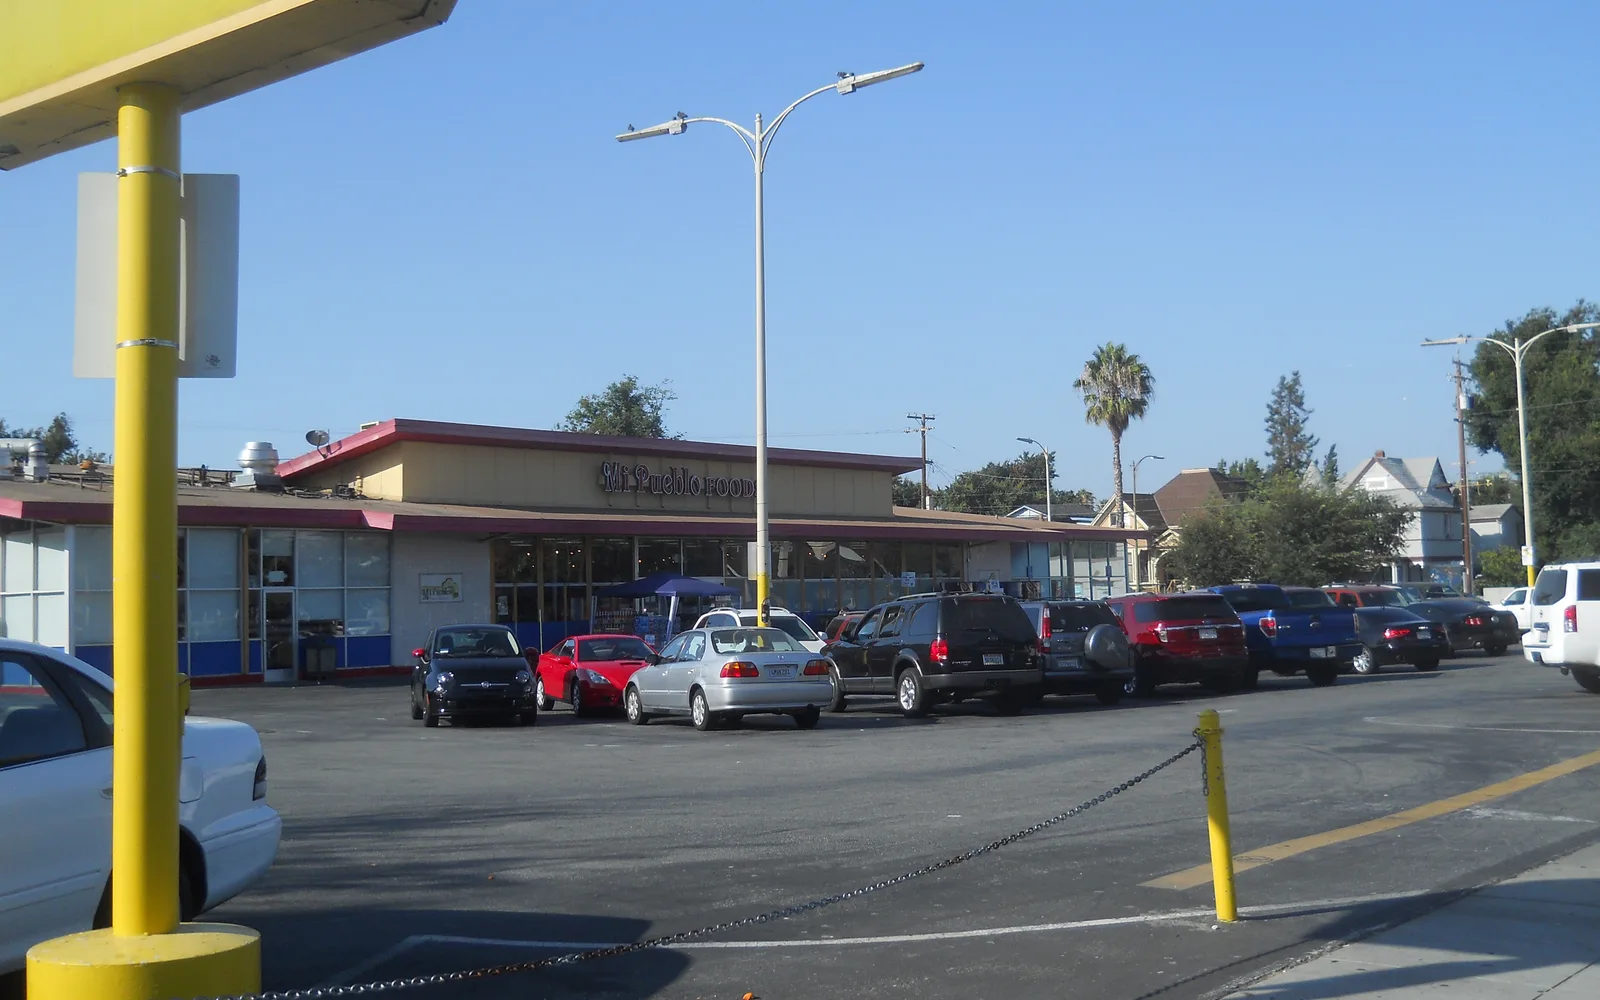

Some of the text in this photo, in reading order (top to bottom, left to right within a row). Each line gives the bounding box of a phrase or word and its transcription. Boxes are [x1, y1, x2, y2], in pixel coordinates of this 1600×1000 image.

[603, 461, 757, 498] Mi Pueblo FOOD
